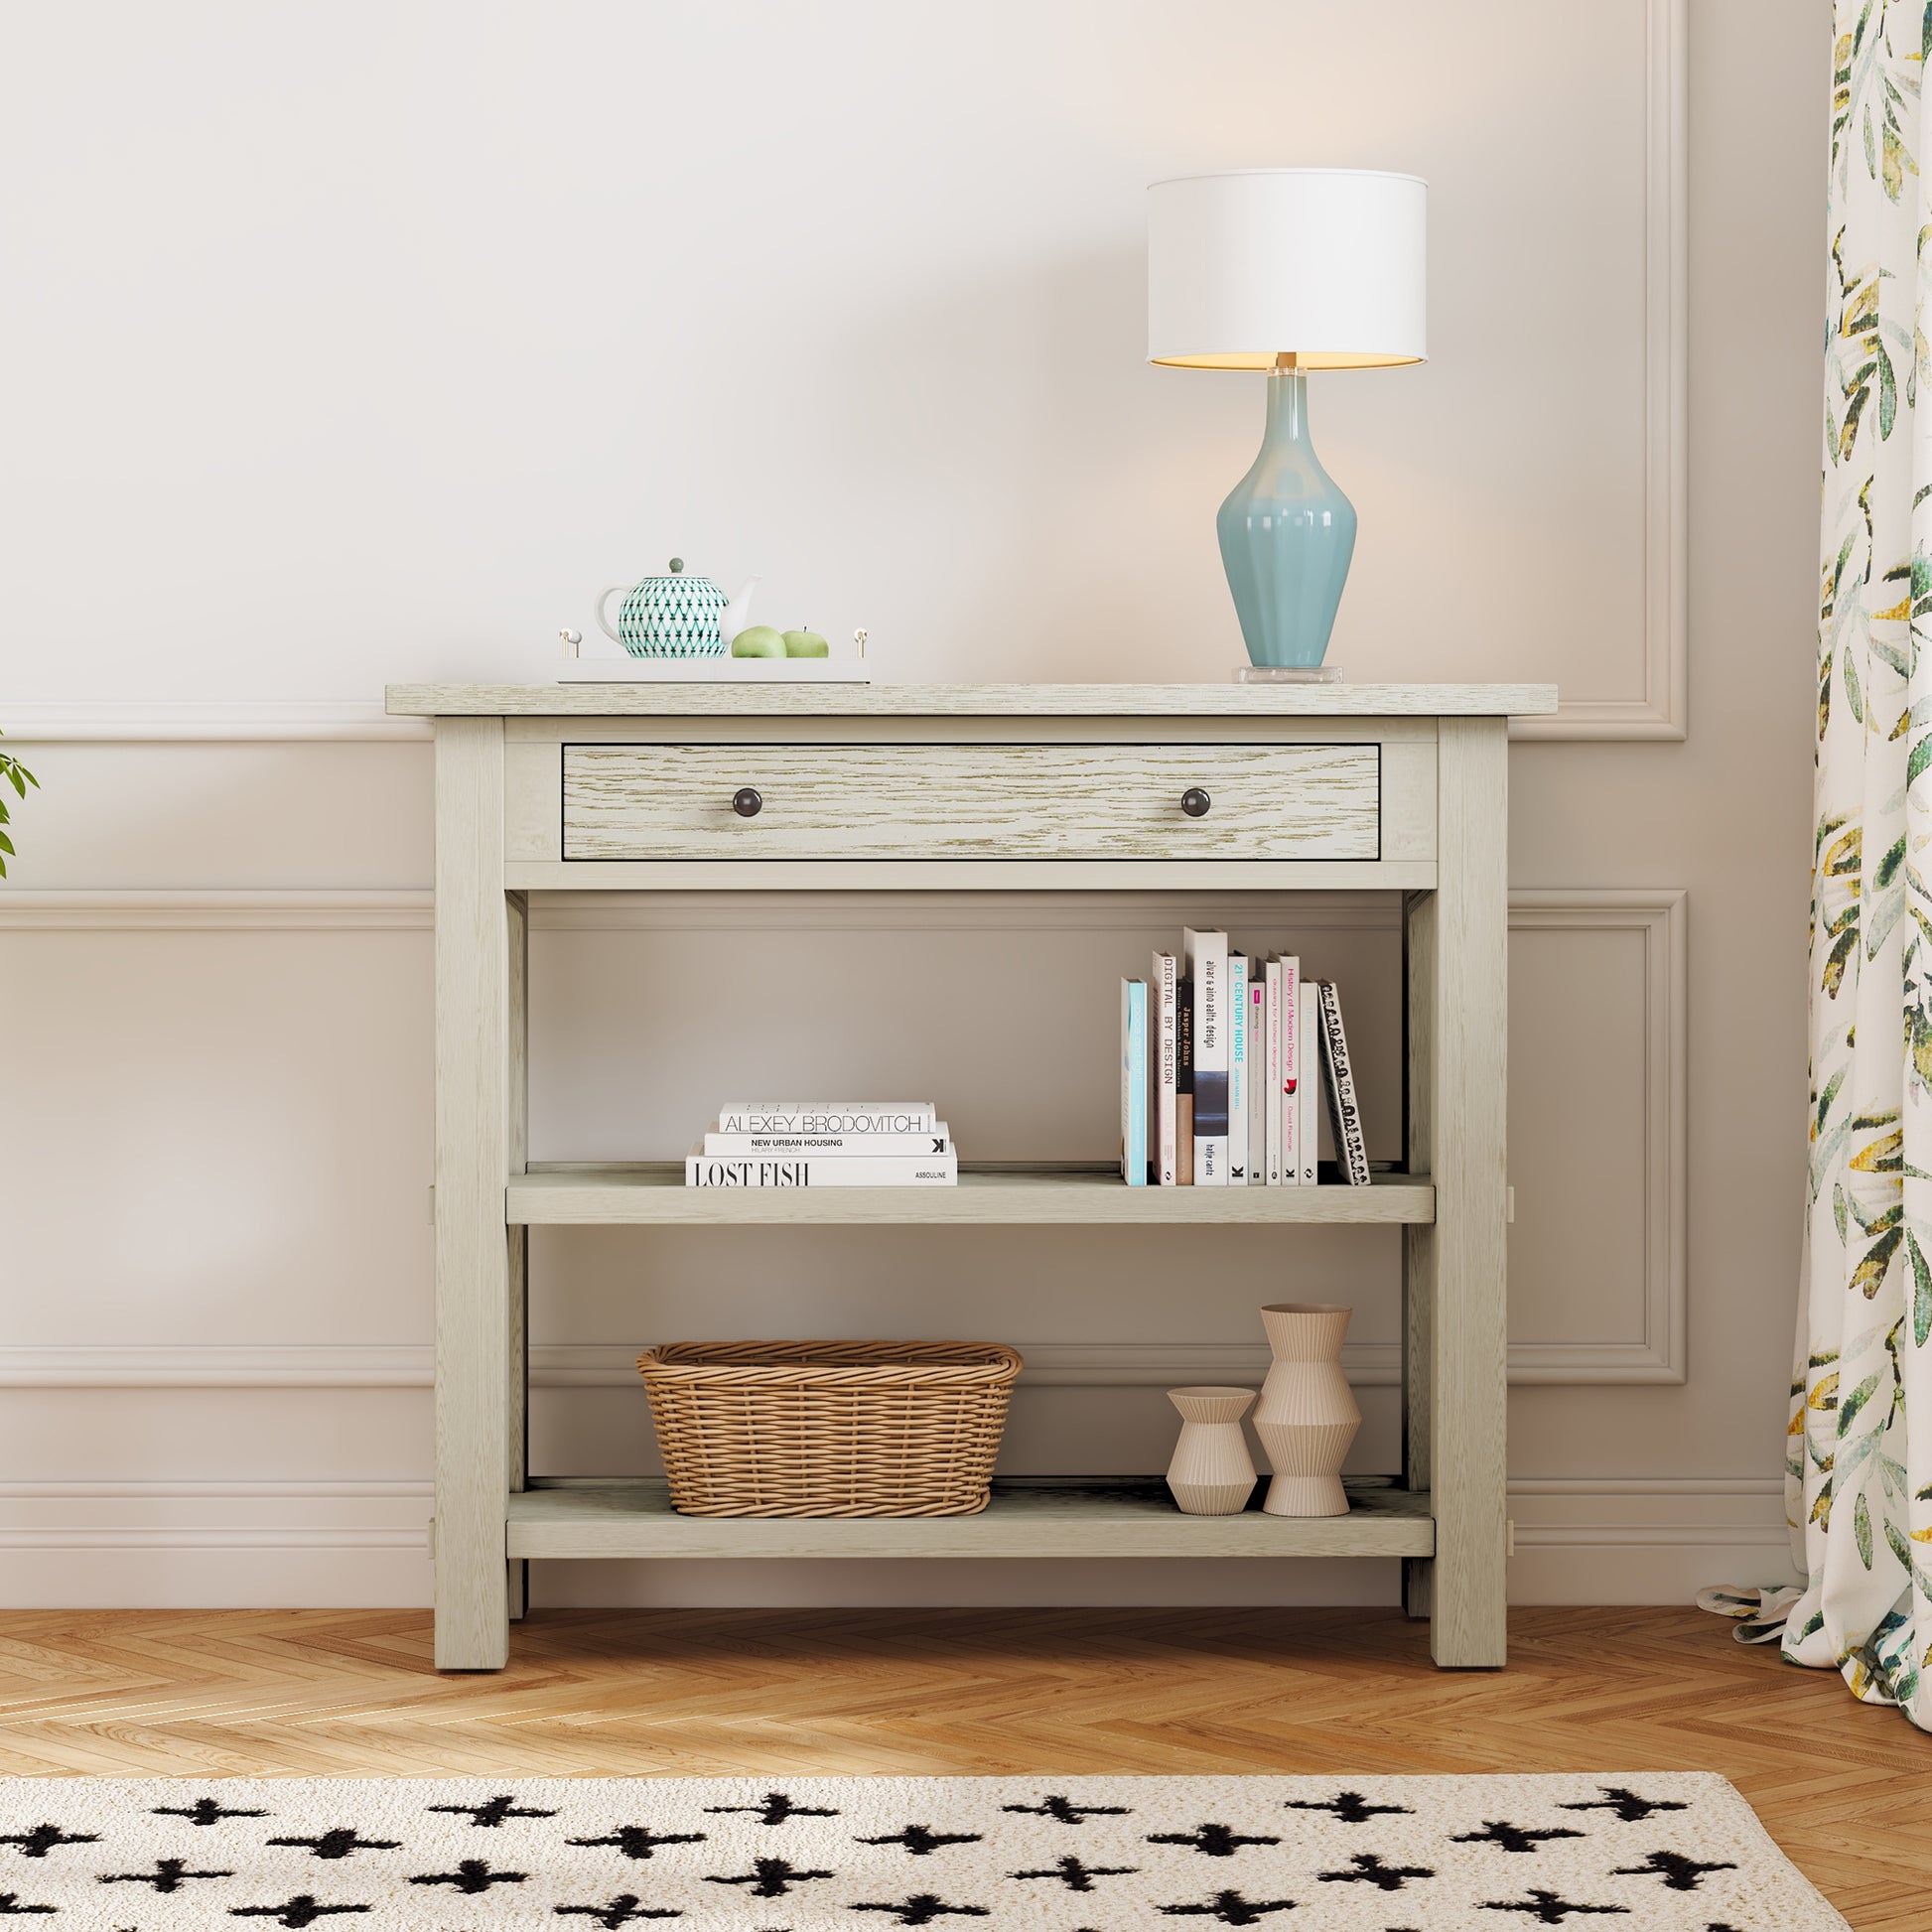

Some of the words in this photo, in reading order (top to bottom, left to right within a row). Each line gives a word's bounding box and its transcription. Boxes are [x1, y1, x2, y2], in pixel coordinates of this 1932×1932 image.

[1206, 960, 1216, 978] alvar
[1165, 958, 1173, 1008] DIGITAL
[1206, 986, 1217, 1003] aino
[1234, 982, 1244, 1028] CENTURY
[1288, 998, 1295, 1008] of
[1165, 1016, 1173, 1031] BY
[1182, 1007, 1191, 1037] Jasper
[1203, 1025, 1217, 1048] design
[1234, 1029, 1244, 1063] HOUSE
[1165, 1038, 1173, 1085] DESIGN
[1286, 1042, 1295, 1071] Design
[724, 1115, 796, 1132] ALEXEY
[802, 1115, 921, 1132] BRODOVITCH
[695, 1163, 754, 1186] LOST
[759, 1163, 809, 1186] FISH
